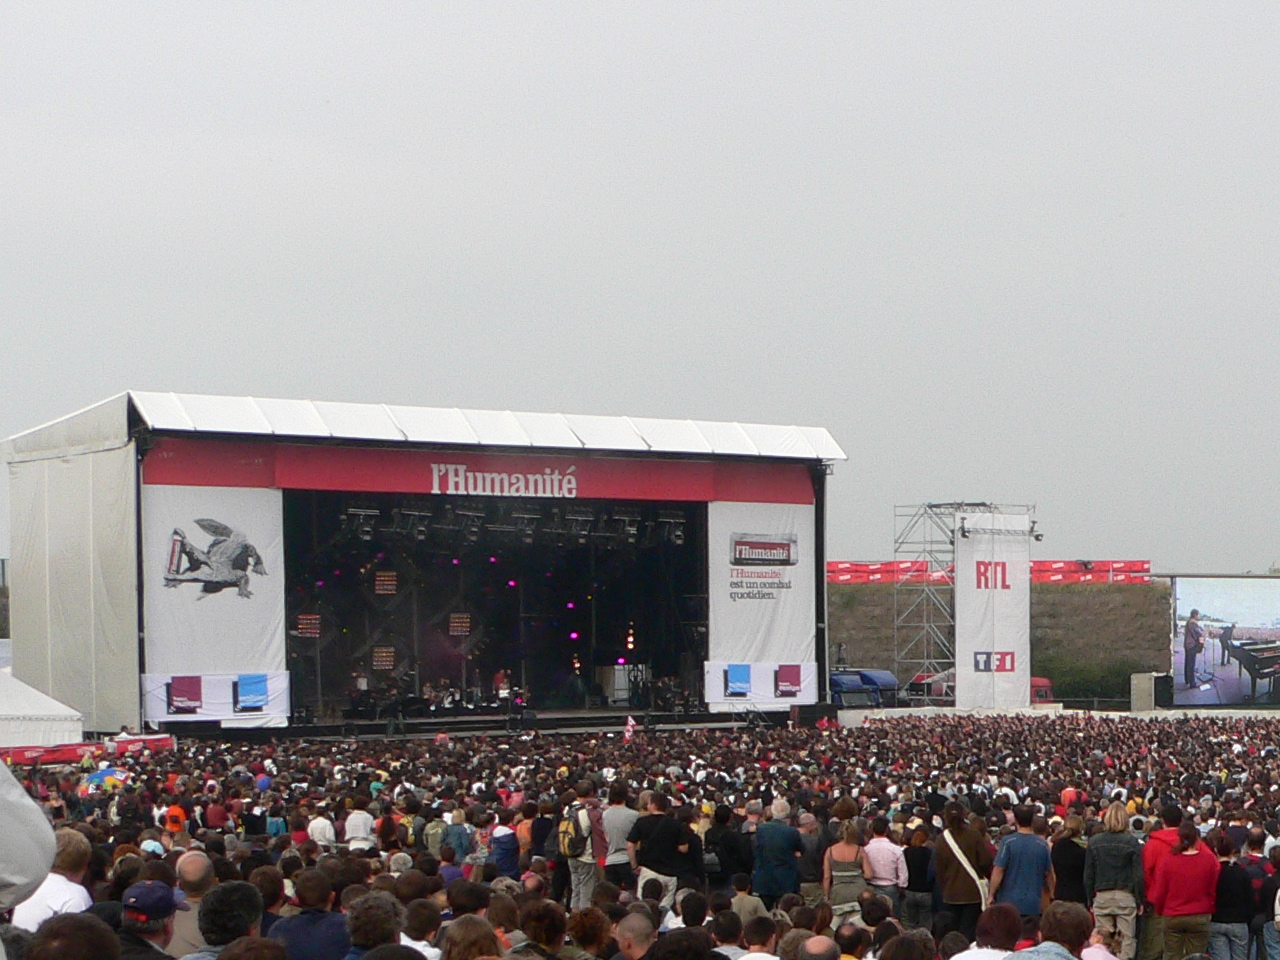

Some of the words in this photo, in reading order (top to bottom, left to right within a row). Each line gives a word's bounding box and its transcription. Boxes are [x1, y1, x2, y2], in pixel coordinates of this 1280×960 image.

[430, 463, 577, 498] l'Humanité
[745, 581, 758, 589] un
[760, 580, 792, 589] combat
[976, 560, 1011, 589] RTL
[975, 653, 1013, 671] TF1
